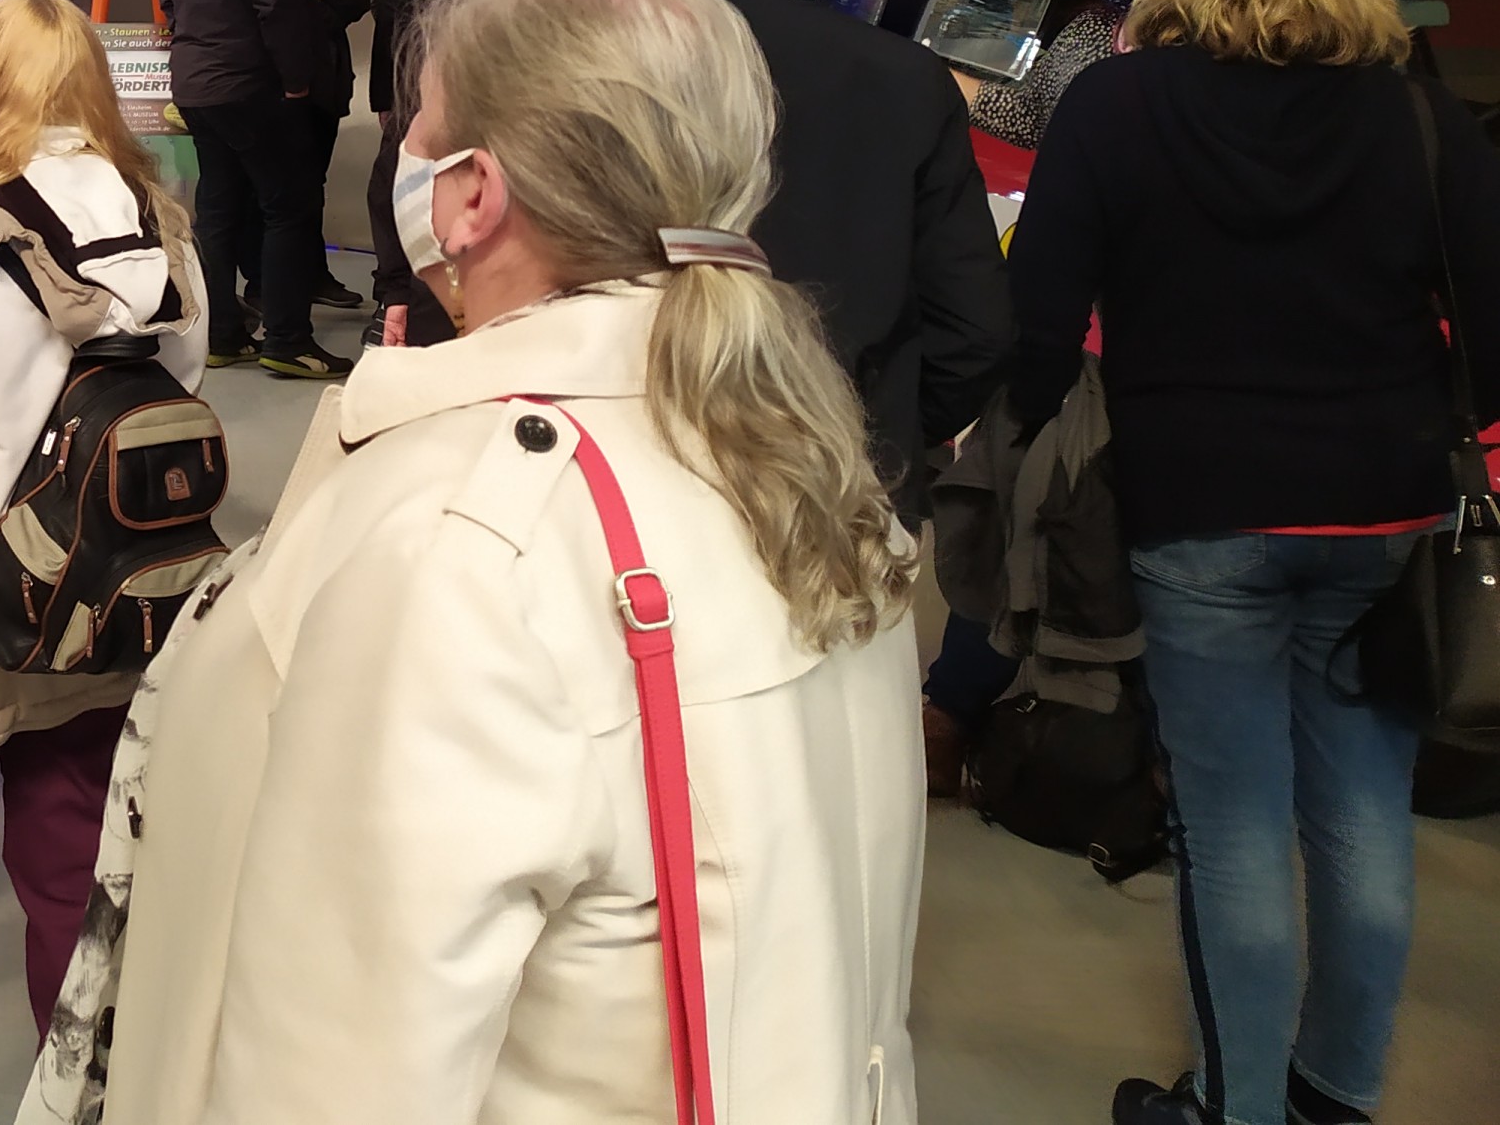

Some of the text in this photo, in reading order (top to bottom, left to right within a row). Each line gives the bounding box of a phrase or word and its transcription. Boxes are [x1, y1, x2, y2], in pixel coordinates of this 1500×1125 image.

[110, 28, 150, 36] Staunen
[113, 39, 127, 48] Sie
[129, 39, 153, 47] auch
[110, 62, 172, 73] LEBNISP
[114, 78, 172, 91] ÖRDERT
